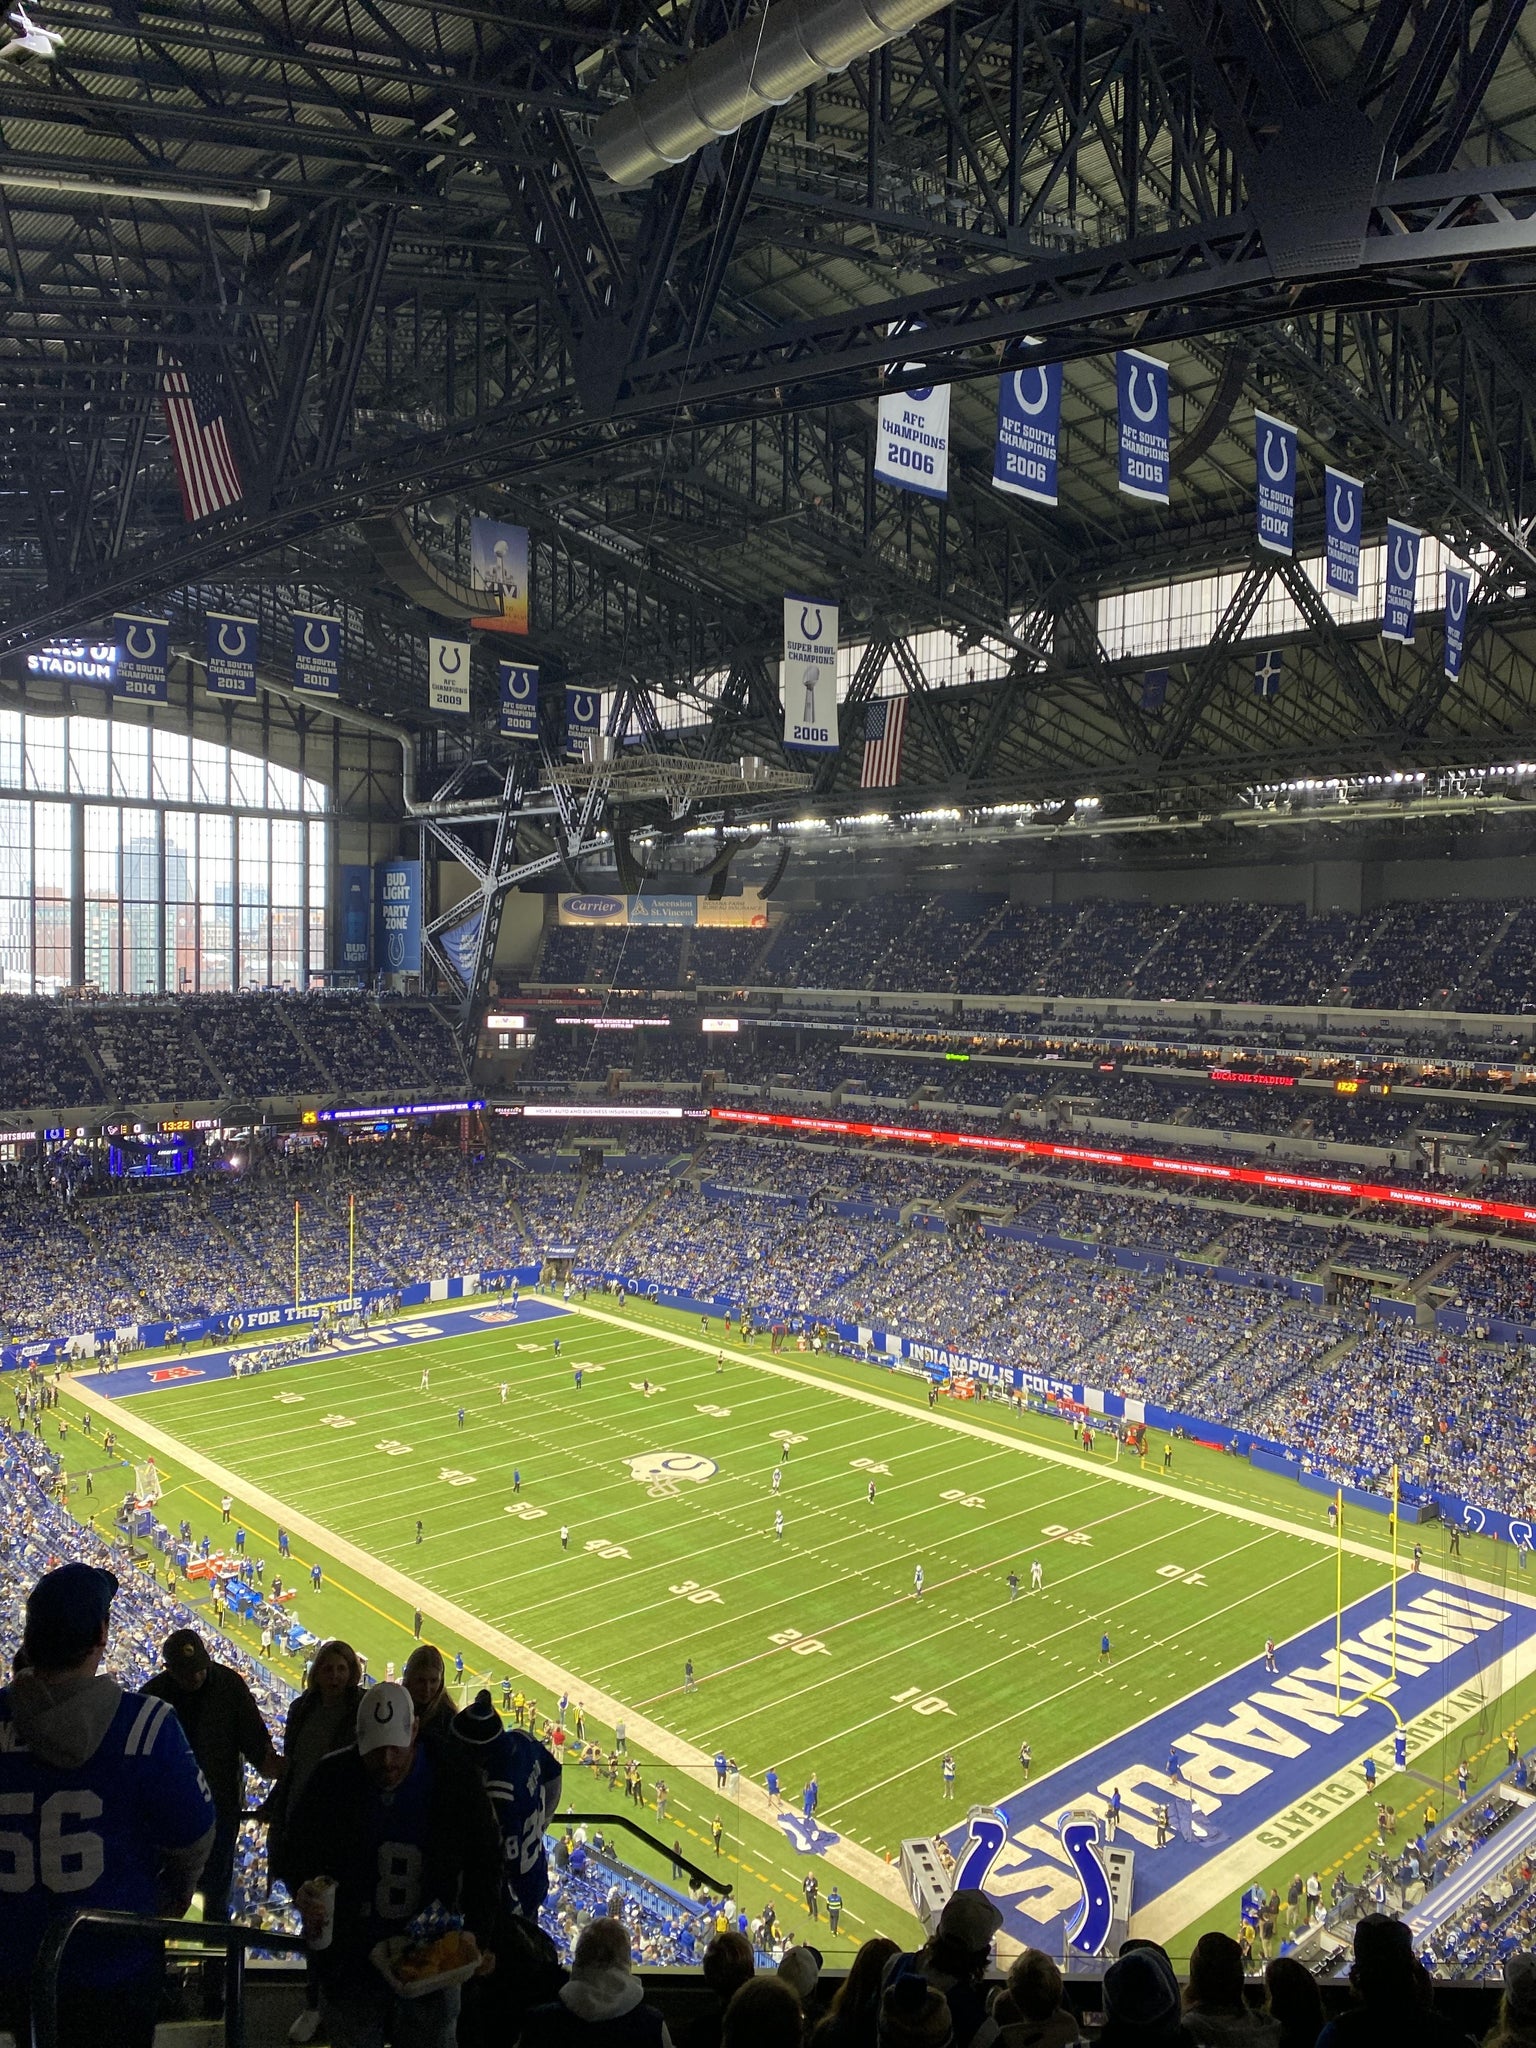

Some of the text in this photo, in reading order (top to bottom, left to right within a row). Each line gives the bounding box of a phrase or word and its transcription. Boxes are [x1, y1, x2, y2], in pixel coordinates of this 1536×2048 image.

[903, 411, 924, 428] AFC
[882, 418, 946, 451] CHAMPIONS
[1002, 416, 1056, 446] AFC SOUTH
[1122, 425, 1168, 449] AFC SOUTH
[1000, 430, 1057, 460] CHAMPIONS
[1121, 439, 1170, 462] CHAMPIONS
[888, 443, 934, 475] 2006
[1006, 452, 1047, 482] 2006
[1127, 458, 1163, 483] 2005
[1260, 514, 1289, 537] 2004
[1331, 564, 1354, 585] 2003
[787, 640, 836, 655] SUPER BOWL
[210, 658, 253, 671] AFC SOUTH
[297, 655, 338, 668] AFC SOUTH
[788, 651, 835, 665] CHAMPIONS
[27, 654, 111, 679] STADIUM
[118, 661, 165, 674] AFC SOUTH
[209, 665, 255, 679] CHAMPIONS
[295, 662, 338, 675] CHAMPIONS
[116, 668, 166, 682] CHAMPIONS
[303, 673, 329, 687] 2010
[443, 678, 457, 687] AFC
[125, 681, 156, 695] 2014
[217, 677, 246, 690] 2013
[432, 683, 468, 695] CHAMPIONS
[436, 694, 462, 706] 2009
[502, 707, 538, 718] CHAMPIONS
[507, 717, 532, 729] 2009
[794, 725, 829, 742] 2006
[573, 739, 589, 749] 200
[386, 872, 407, 886] BUD
[382, 886, 411, 900] LIGHT
[382, 905, 410, 918] PARTY
[571, 899, 616, 912] Carrier
[651, 899, 693, 908] Ascension
[650, 908, 694, 917] St. Vincent
[385, 918, 408, 930] ZONE
[345, 943, 366, 953] BUD
[1211, 1071, 1295, 1086] LUCAS OIL STADIUM
[302, 1111, 317, 1124] 25
[76, 1127, 84, 1138] 0
[133, 1123, 141, 1134] 0
[161, 1121, 190, 1132] 13:22
[195, 1119, 211, 1130] QTR
[212, 1119, 218, 1128] 1
[1053, 1147, 1064, 1155] FAN
[1085, 1151, 1106, 1160] THIRSTY
[1106, 1154, 1123, 1162] WORK
[1152, 1160, 1164, 1168] FAN
[1164, 1162, 1182, 1170] WORK
[1188, 1165, 1212, 1174] THIRSTY
[1212, 1168, 1231, 1177] WORK
[1264, 1175, 1277, 1183] FAN
[1277, 1176, 1296, 1185] WORK
[1304, 1180, 1331, 1190] THIRSTY
[1331, 1183, 1352, 1193] WORK
[1390, 1191, 1403, 1199] FAN
[1403, 1193, 1425, 1202] WORK
[1431, 1197, 1460, 1208] THIRSTY
[1460, 1201, 1483, 1211] WORK
[1524, 1211, 1536, 1219] FAN
[247, 1310, 281, 1327] FOR
[285, 1306, 320, 1321] THE
[909, 1343, 1075, 1400] INDIANAPOLIS COLTS
[320, 1414, 357, 1429] 20
[768, 1429, 809, 1445] 50
[375, 1440, 413, 1456] 30
[438, 1468, 478, 1487] 40
[939, 1489, 986, 1508] 30
[503, 1501, 548, 1520] 50
[1040, 1524, 1093, 1545] 20
[583, 1539, 625, 1560] 40
[1155, 1564, 1206, 1585] 10
[668, 1580, 720, 1605] 30
[766, 1628, 826, 1656] 20
[889, 1686, 950, 1716] 10
[1447, 1688, 1488, 1714] MY
[1256, 1782, 1357, 1850] CLEATS
[0, 1788, 104, 1893] 56
[376, 1840, 424, 1919] 8
